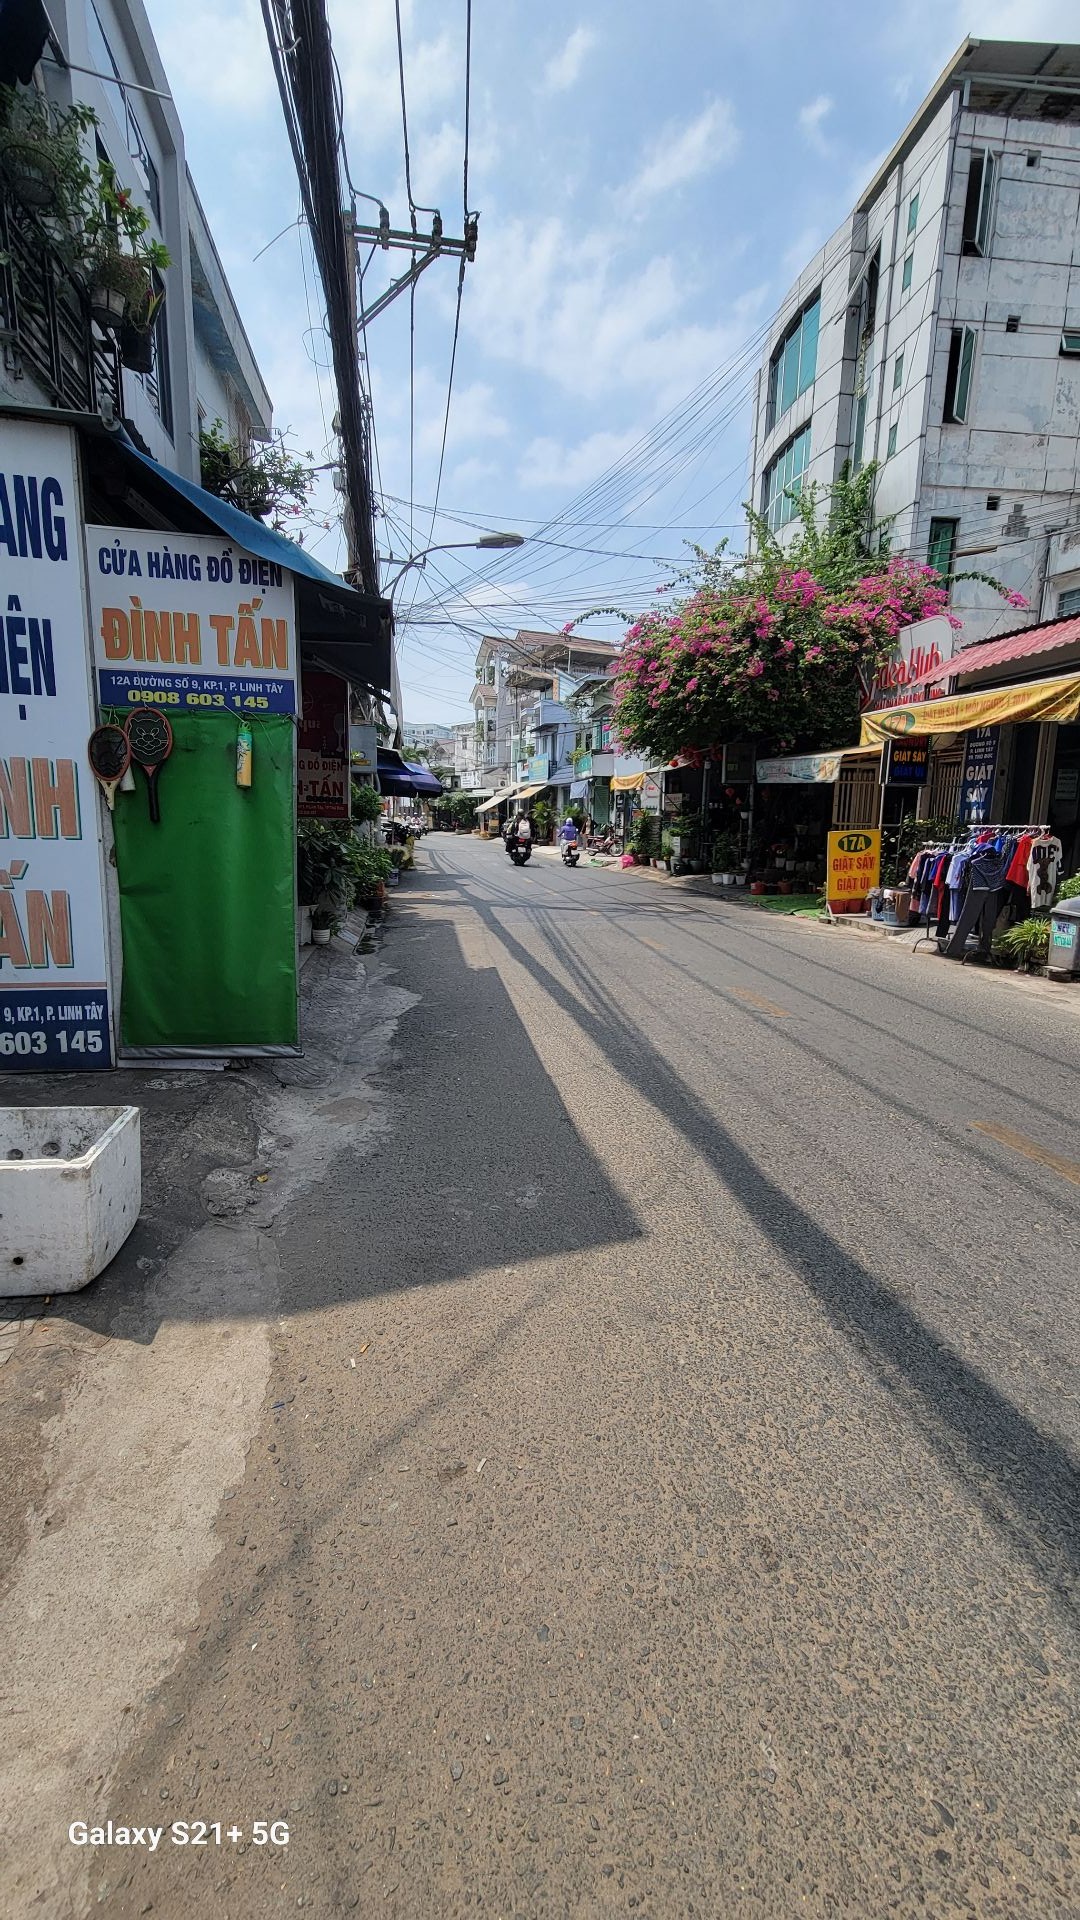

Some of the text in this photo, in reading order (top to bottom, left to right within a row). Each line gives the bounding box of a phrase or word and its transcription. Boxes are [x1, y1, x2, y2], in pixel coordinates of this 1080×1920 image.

[99, 539, 142, 576] CỬA
[147, 546, 201, 581] HÀNG
[207, 548, 233, 583] ĐỒ
[101, 596, 288, 670] ĐÌNH TẤN
[111, 676, 131, 686] 12A
[133, 674, 172, 688] ĐƯỜNG
[174, 676, 189, 689] SỐ
[229, 683, 238, 692] P.
[240, 683, 263, 693] LINH
[265, 683, 284, 694] TÂY
[127, 689, 269, 709] 0908 603 145
[976, 728, 991, 738] 17A
[841, 836, 866, 851] 17A
[856, 852, 876, 871] SẤY
[4, 1007, 15, 1025] 9,
[46, 1006, 55, 1021] P.
[58, 1005, 82, 1021] LINH
[84, 1001, 104, 1020] TÂY
[0, 1030, 103, 1055] 603 145
